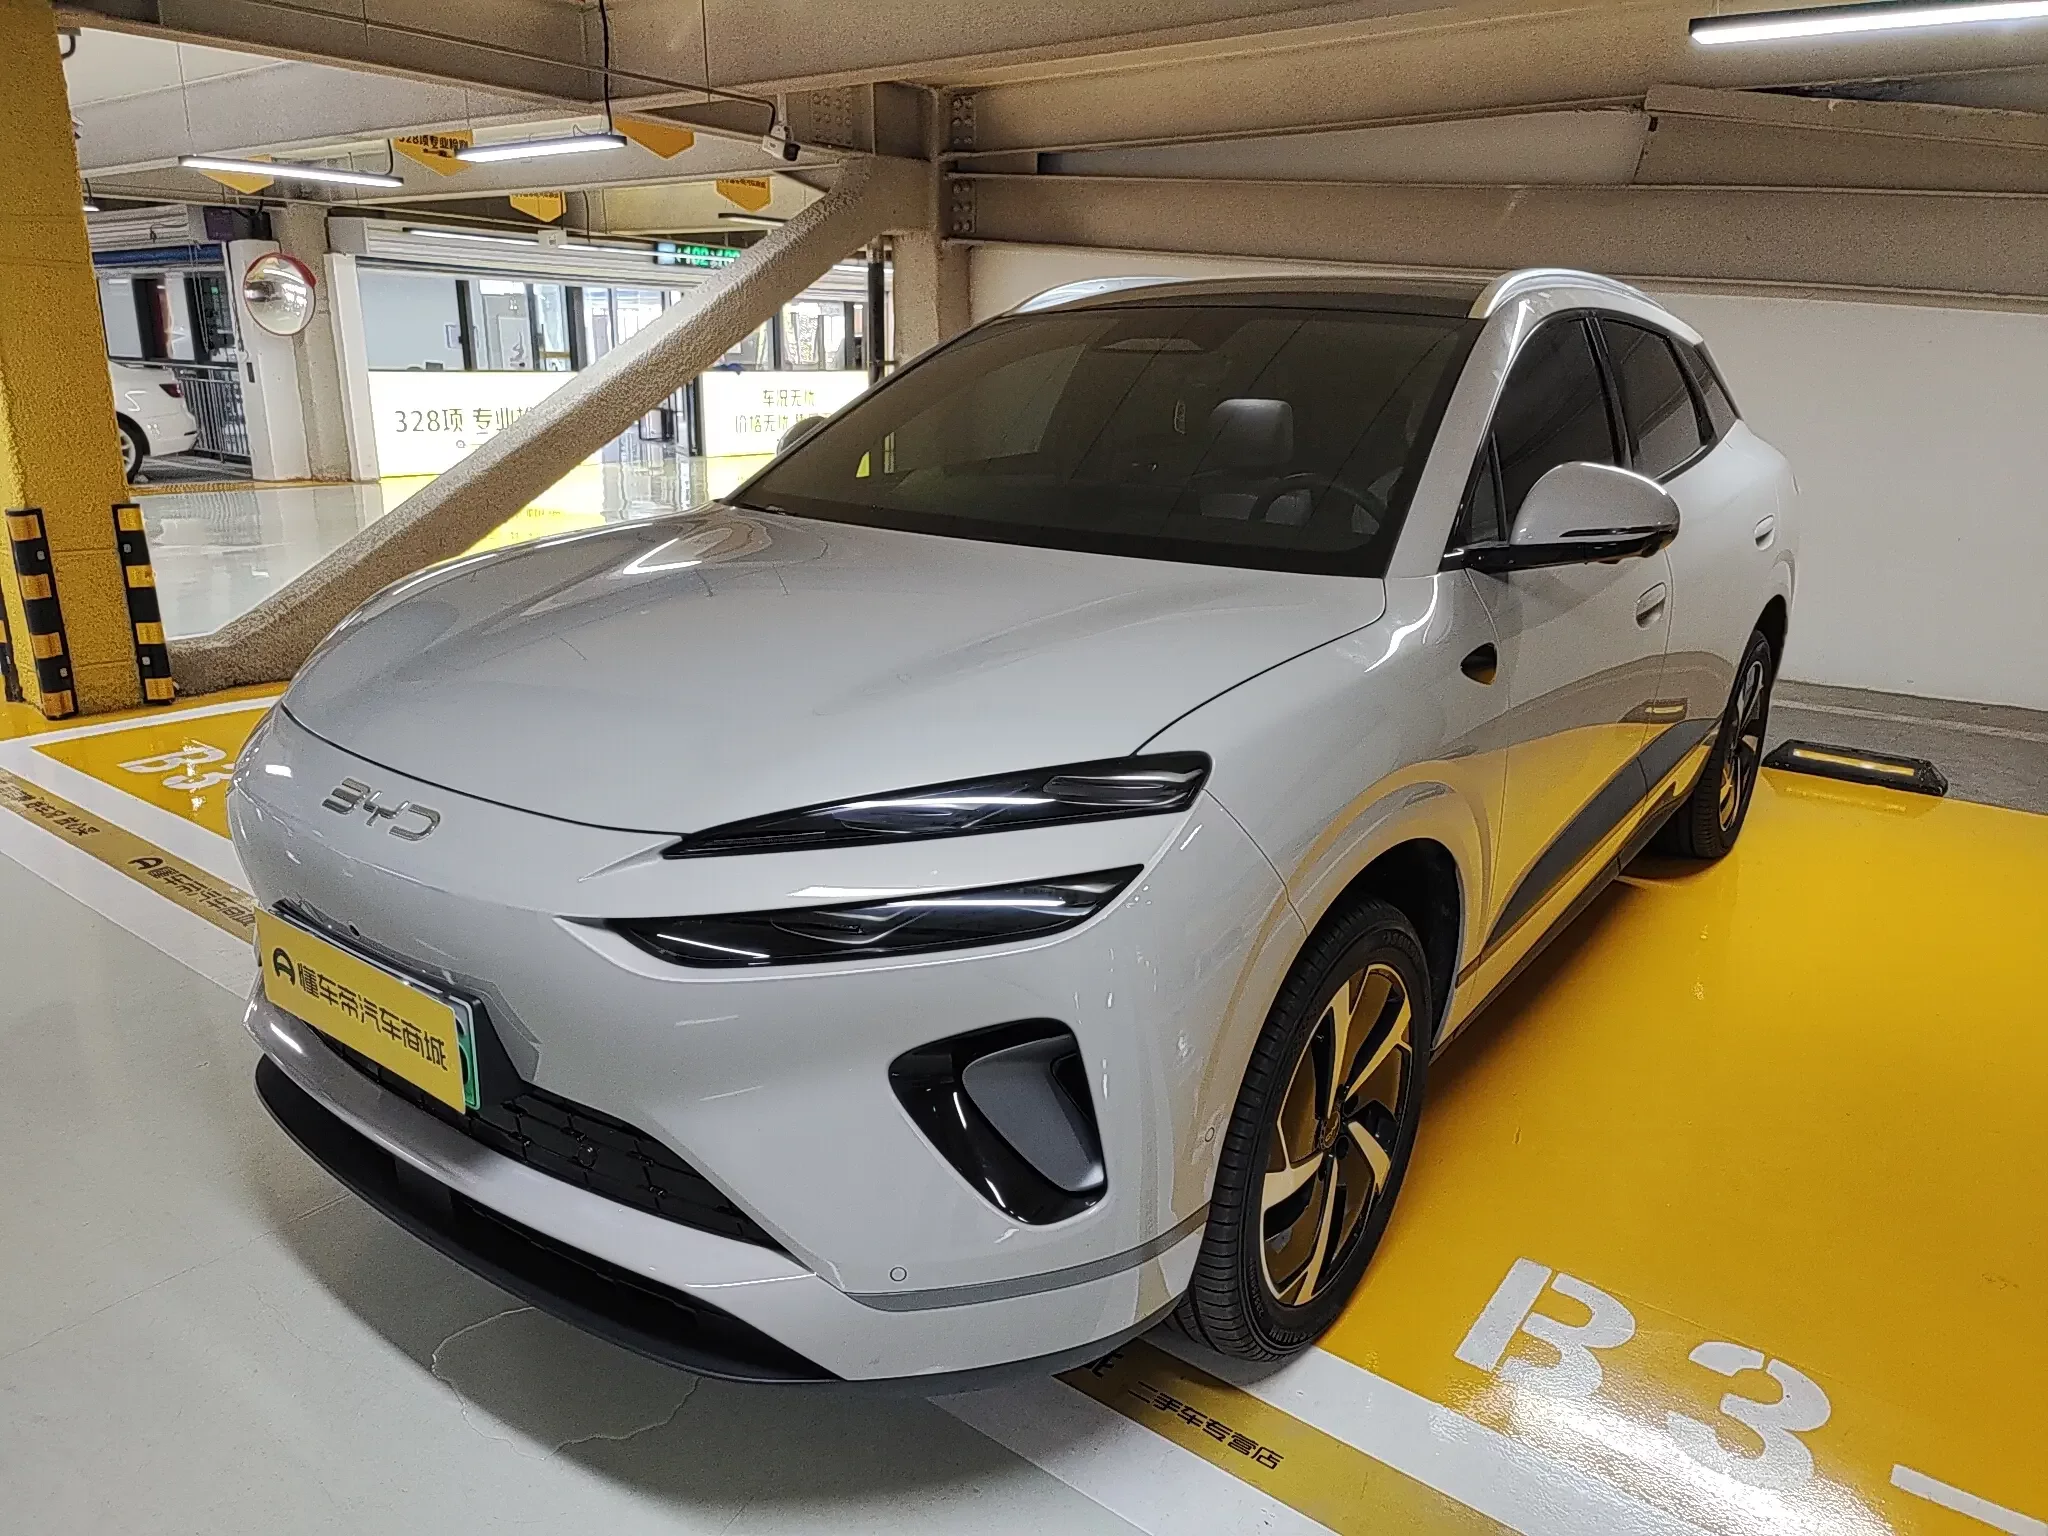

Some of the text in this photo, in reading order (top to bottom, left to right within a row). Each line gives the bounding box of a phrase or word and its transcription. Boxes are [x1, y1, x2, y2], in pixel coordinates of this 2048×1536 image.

[395, 408, 463, 433] 328项
[321, 777, 441, 842] BYD
[297, 962, 449, 1072] 懂车帝汽车商城
[1127, 1380, 1285, 1470] 二手车专营店
